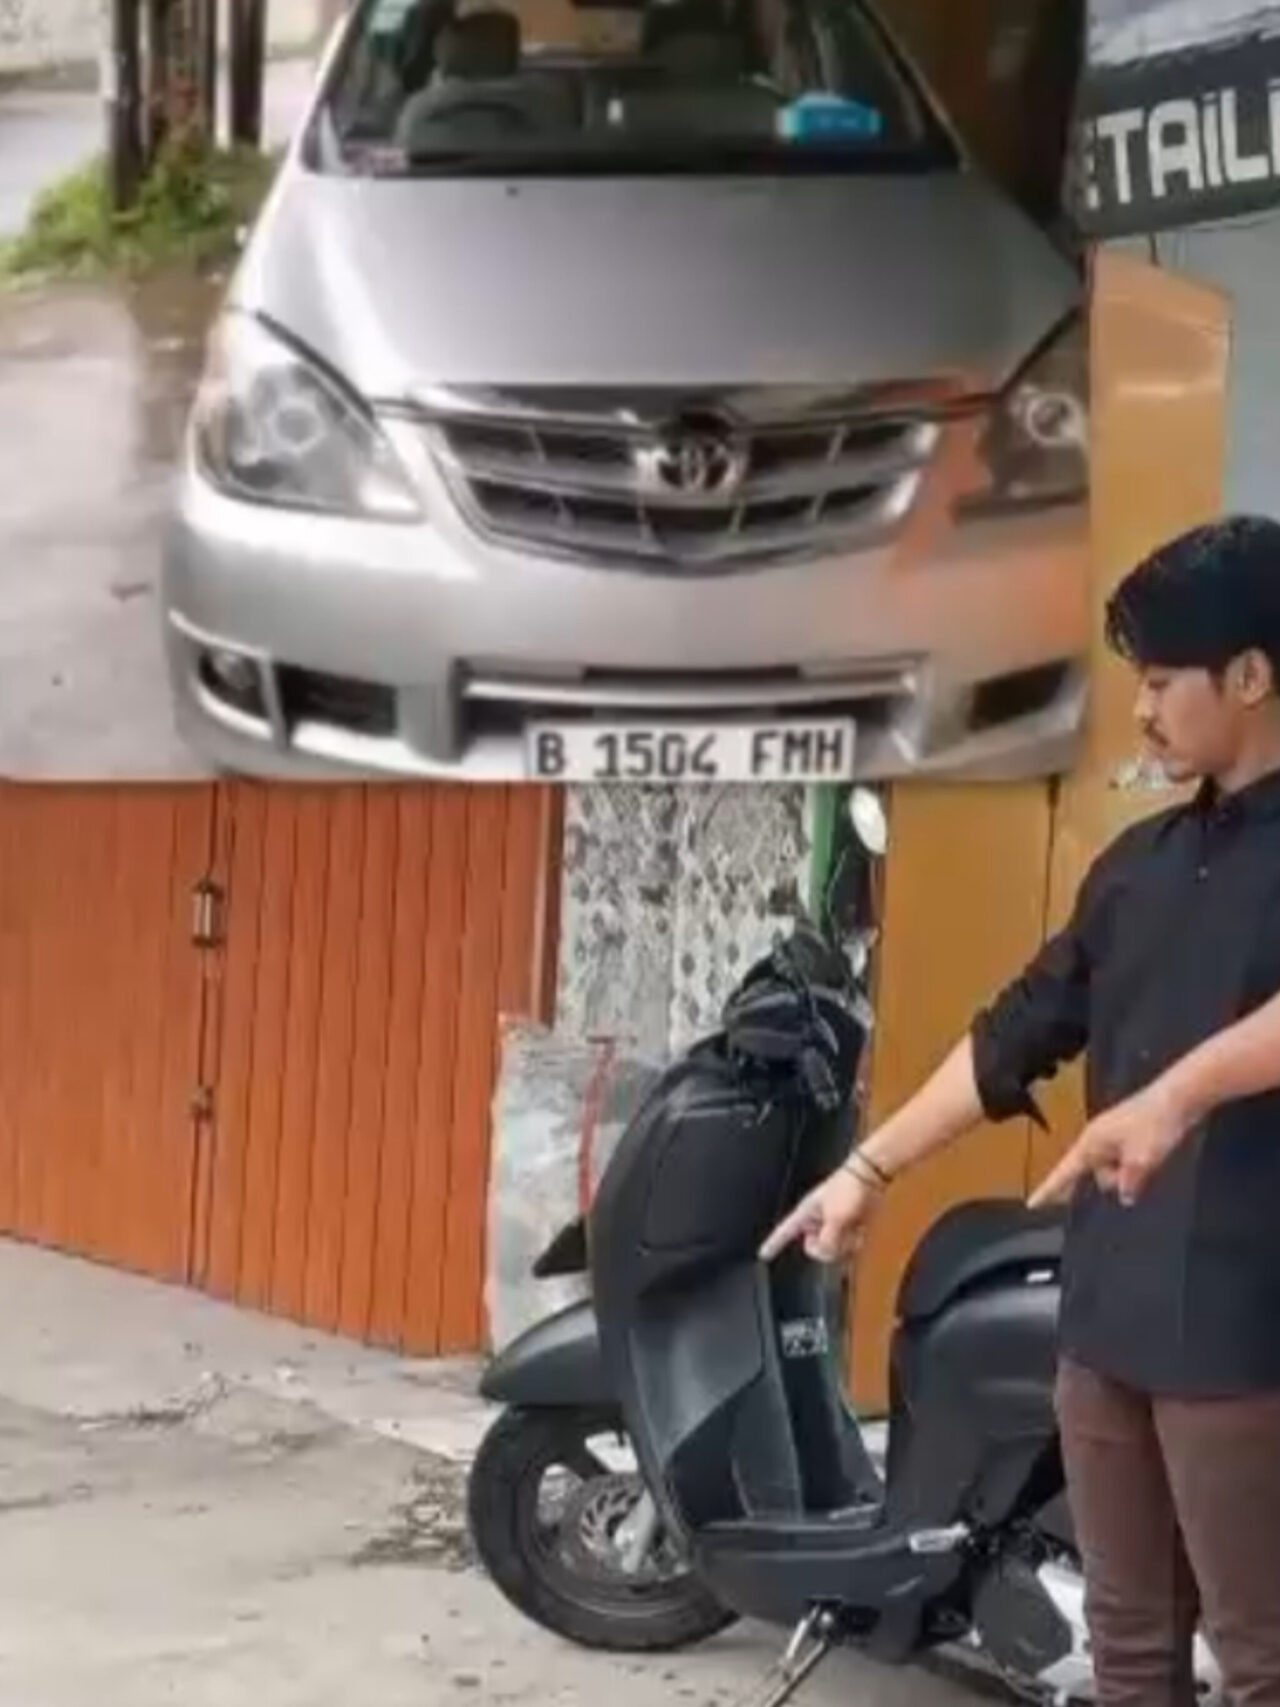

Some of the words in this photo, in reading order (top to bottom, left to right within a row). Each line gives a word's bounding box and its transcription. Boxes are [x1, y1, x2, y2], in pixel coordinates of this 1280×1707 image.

[536, 730, 566, 777] B
[593, 732, 720, 778] 1504
[751, 727, 845, 776] FMH
